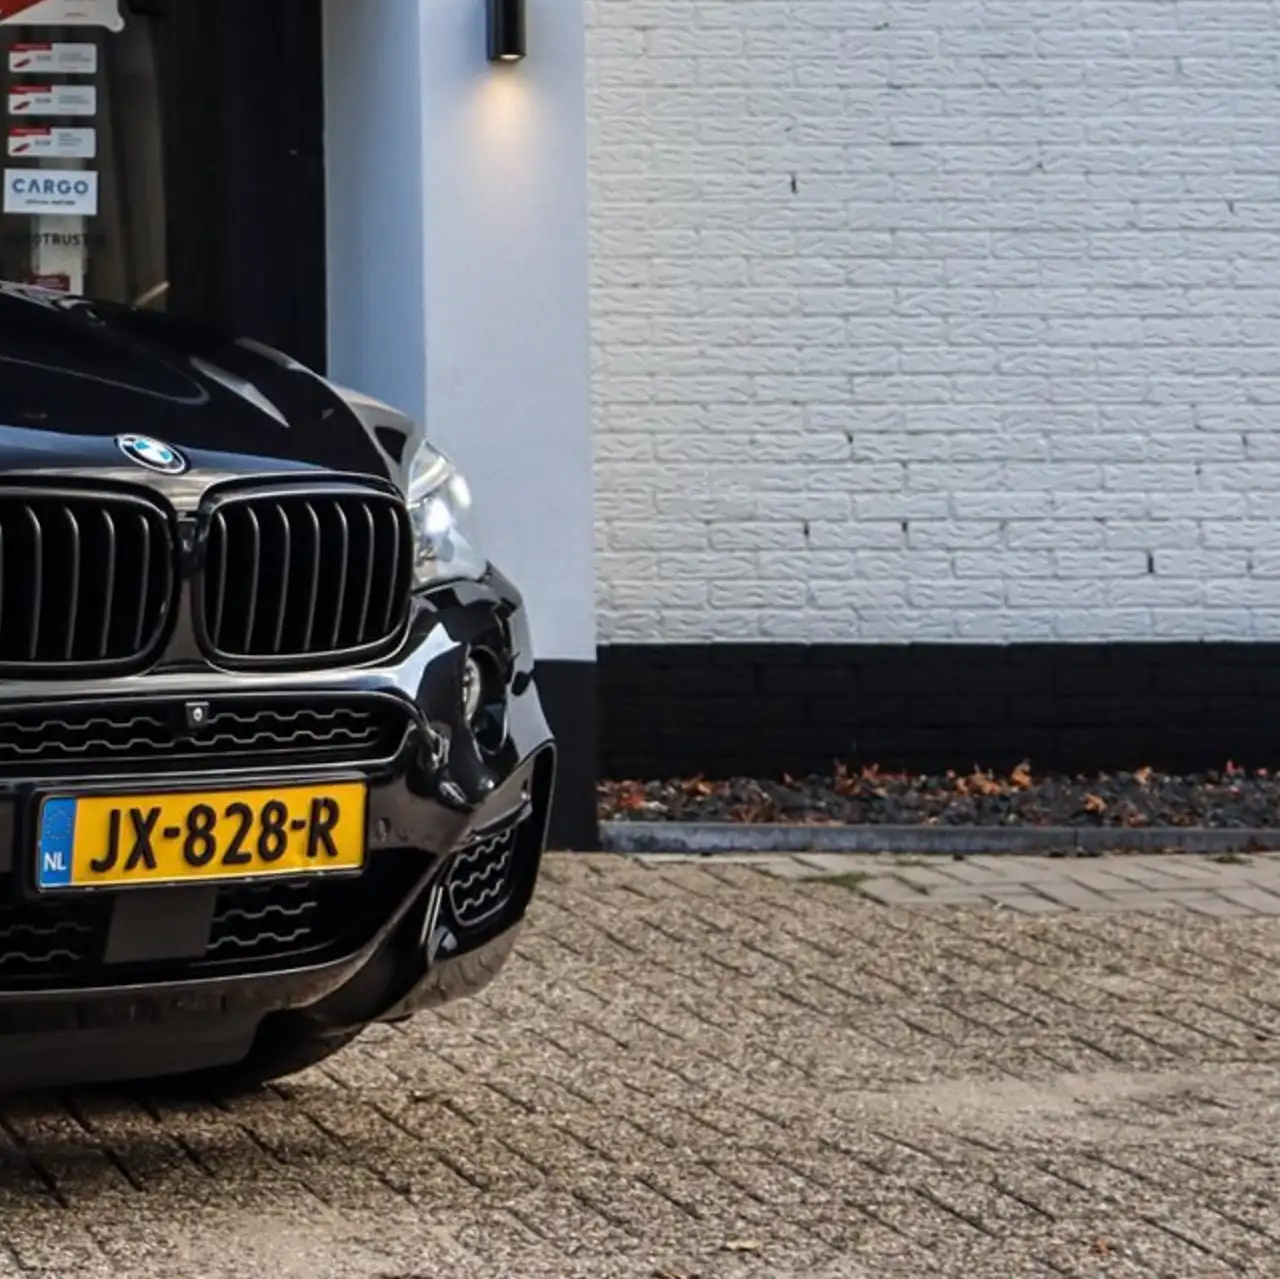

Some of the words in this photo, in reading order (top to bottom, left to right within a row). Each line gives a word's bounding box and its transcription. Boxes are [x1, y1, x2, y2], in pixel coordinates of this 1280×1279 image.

[11, 177, 89, 194] CARGO
[90, 797, 340, 874] JX-828-R
[43, 851, 67, 872] NL
